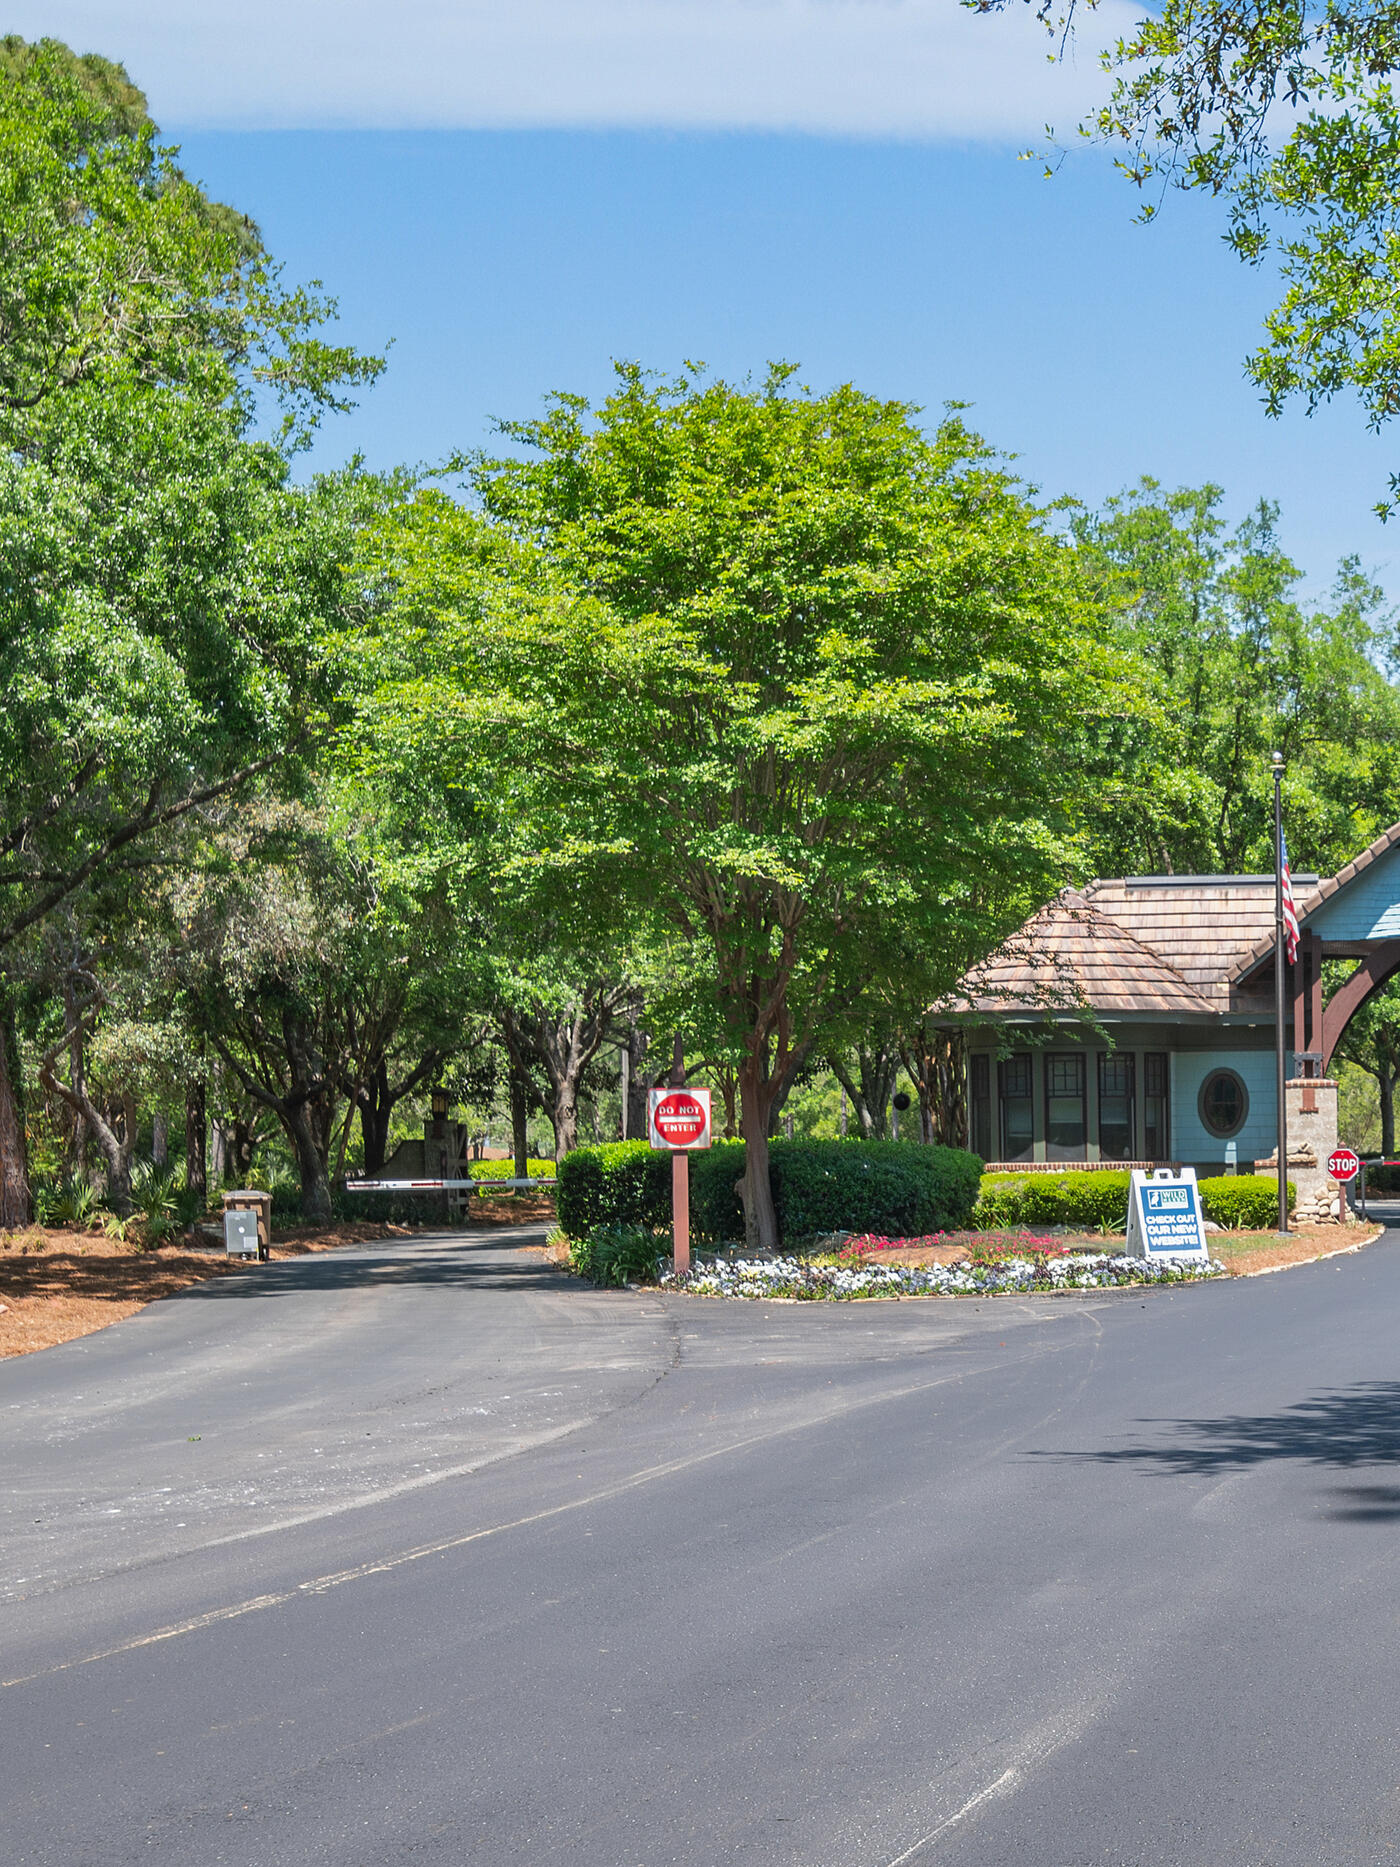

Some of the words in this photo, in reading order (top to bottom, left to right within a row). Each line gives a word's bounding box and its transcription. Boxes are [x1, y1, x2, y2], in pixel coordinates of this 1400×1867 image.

[659, 1105, 674, 1115] DO
[680, 1105, 699, 1115] NOT
[664, 1123, 697, 1132] ENTER
[1328, 1158, 1357, 1171] STOP
[1146, 1215, 1176, 1224] CHECK
[1176, 1214, 1196, 1223] OUT
[1147, 1225, 1171, 1235] OUR
[1171, 1224, 1197, 1234] NEW
